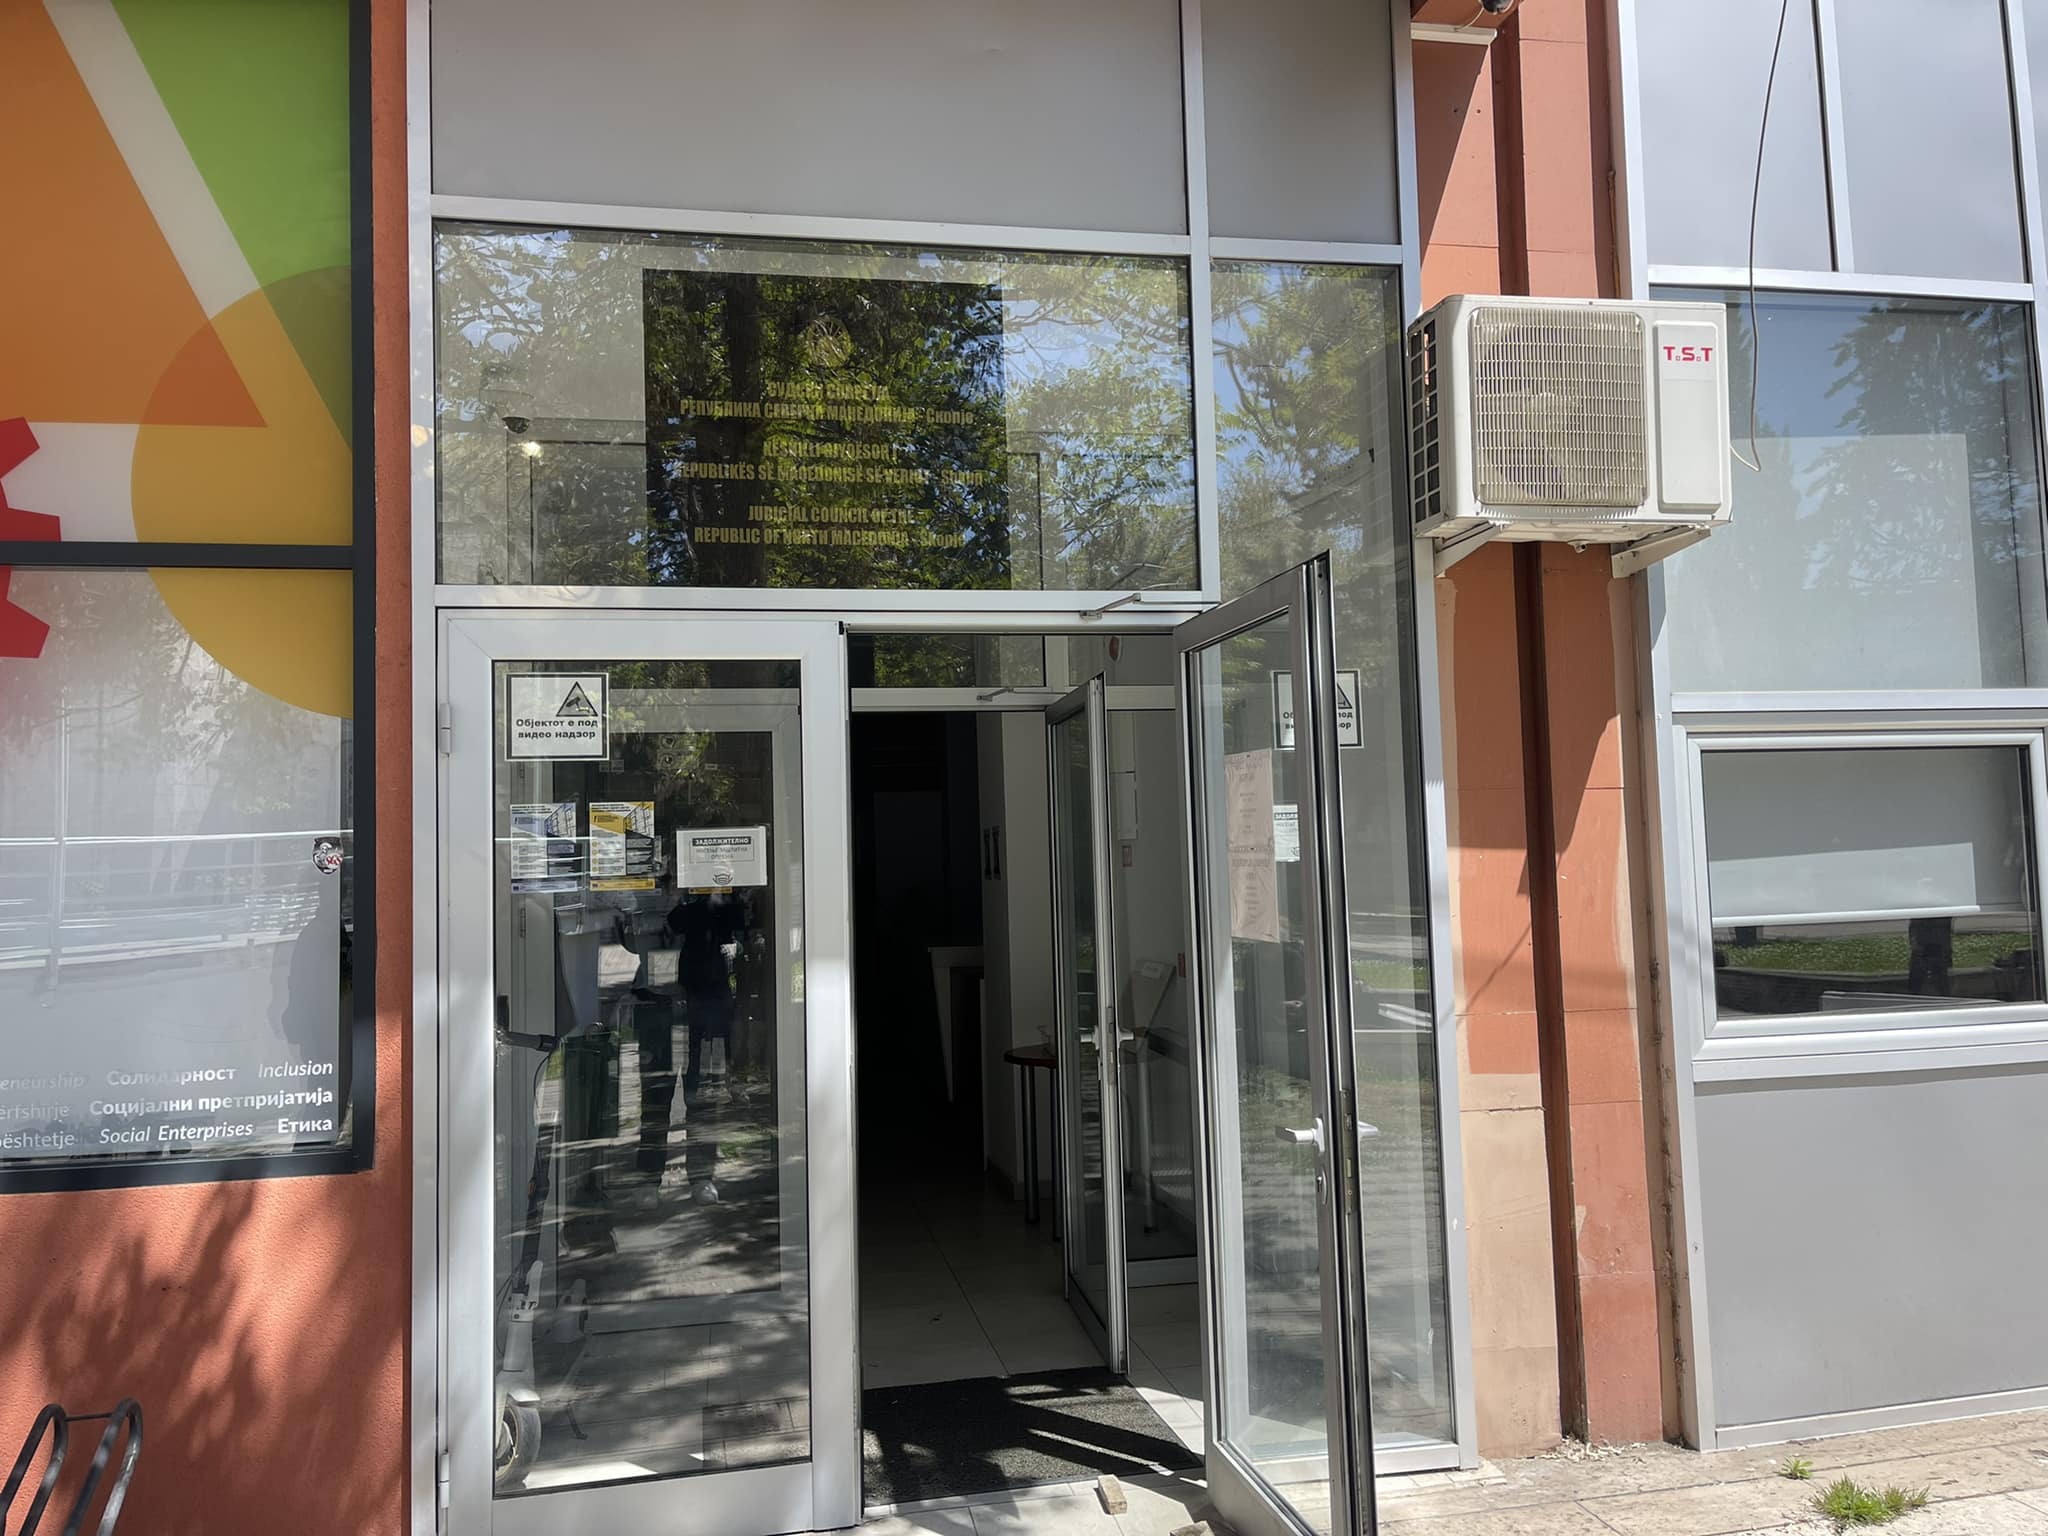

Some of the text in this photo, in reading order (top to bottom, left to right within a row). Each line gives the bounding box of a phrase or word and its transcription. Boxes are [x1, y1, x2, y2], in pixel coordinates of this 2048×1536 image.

[1663, 346, 1713, 362] T.S.T
[680, 400, 762, 418] РЕПУБЛИКА
[926, 407, 974, 425] Скопје
[748, 505, 808, 523] JUDICIAL
[811, 507, 869, 524] COUNCIL
[694, 527, 761, 544] REPUBLIC
[764, 528, 779, 545] OF
[831, 530, 909, 547] MACEDONIA
[516, 718, 565, 728] Објектот
[578, 720, 598, 728] под
[518, 731, 596, 740] видео надзор
[696, 838, 749, 846] ЗАДОЛЖИТЕЛНО
[107, 1067, 236, 1086] Солидарност
[259, 1060, 333, 1079] Inclusion
[0, 1072, 85, 1091] eneurship
[0, 1102, 70, 1120] ërfshirje
[90, 1088, 333, 1117] Социјални претпријатија
[100, 1122, 253, 1144] Social Enterprises
[278, 1118, 333, 1134] Етика
[0, 1130, 75, 1149] ështetje
